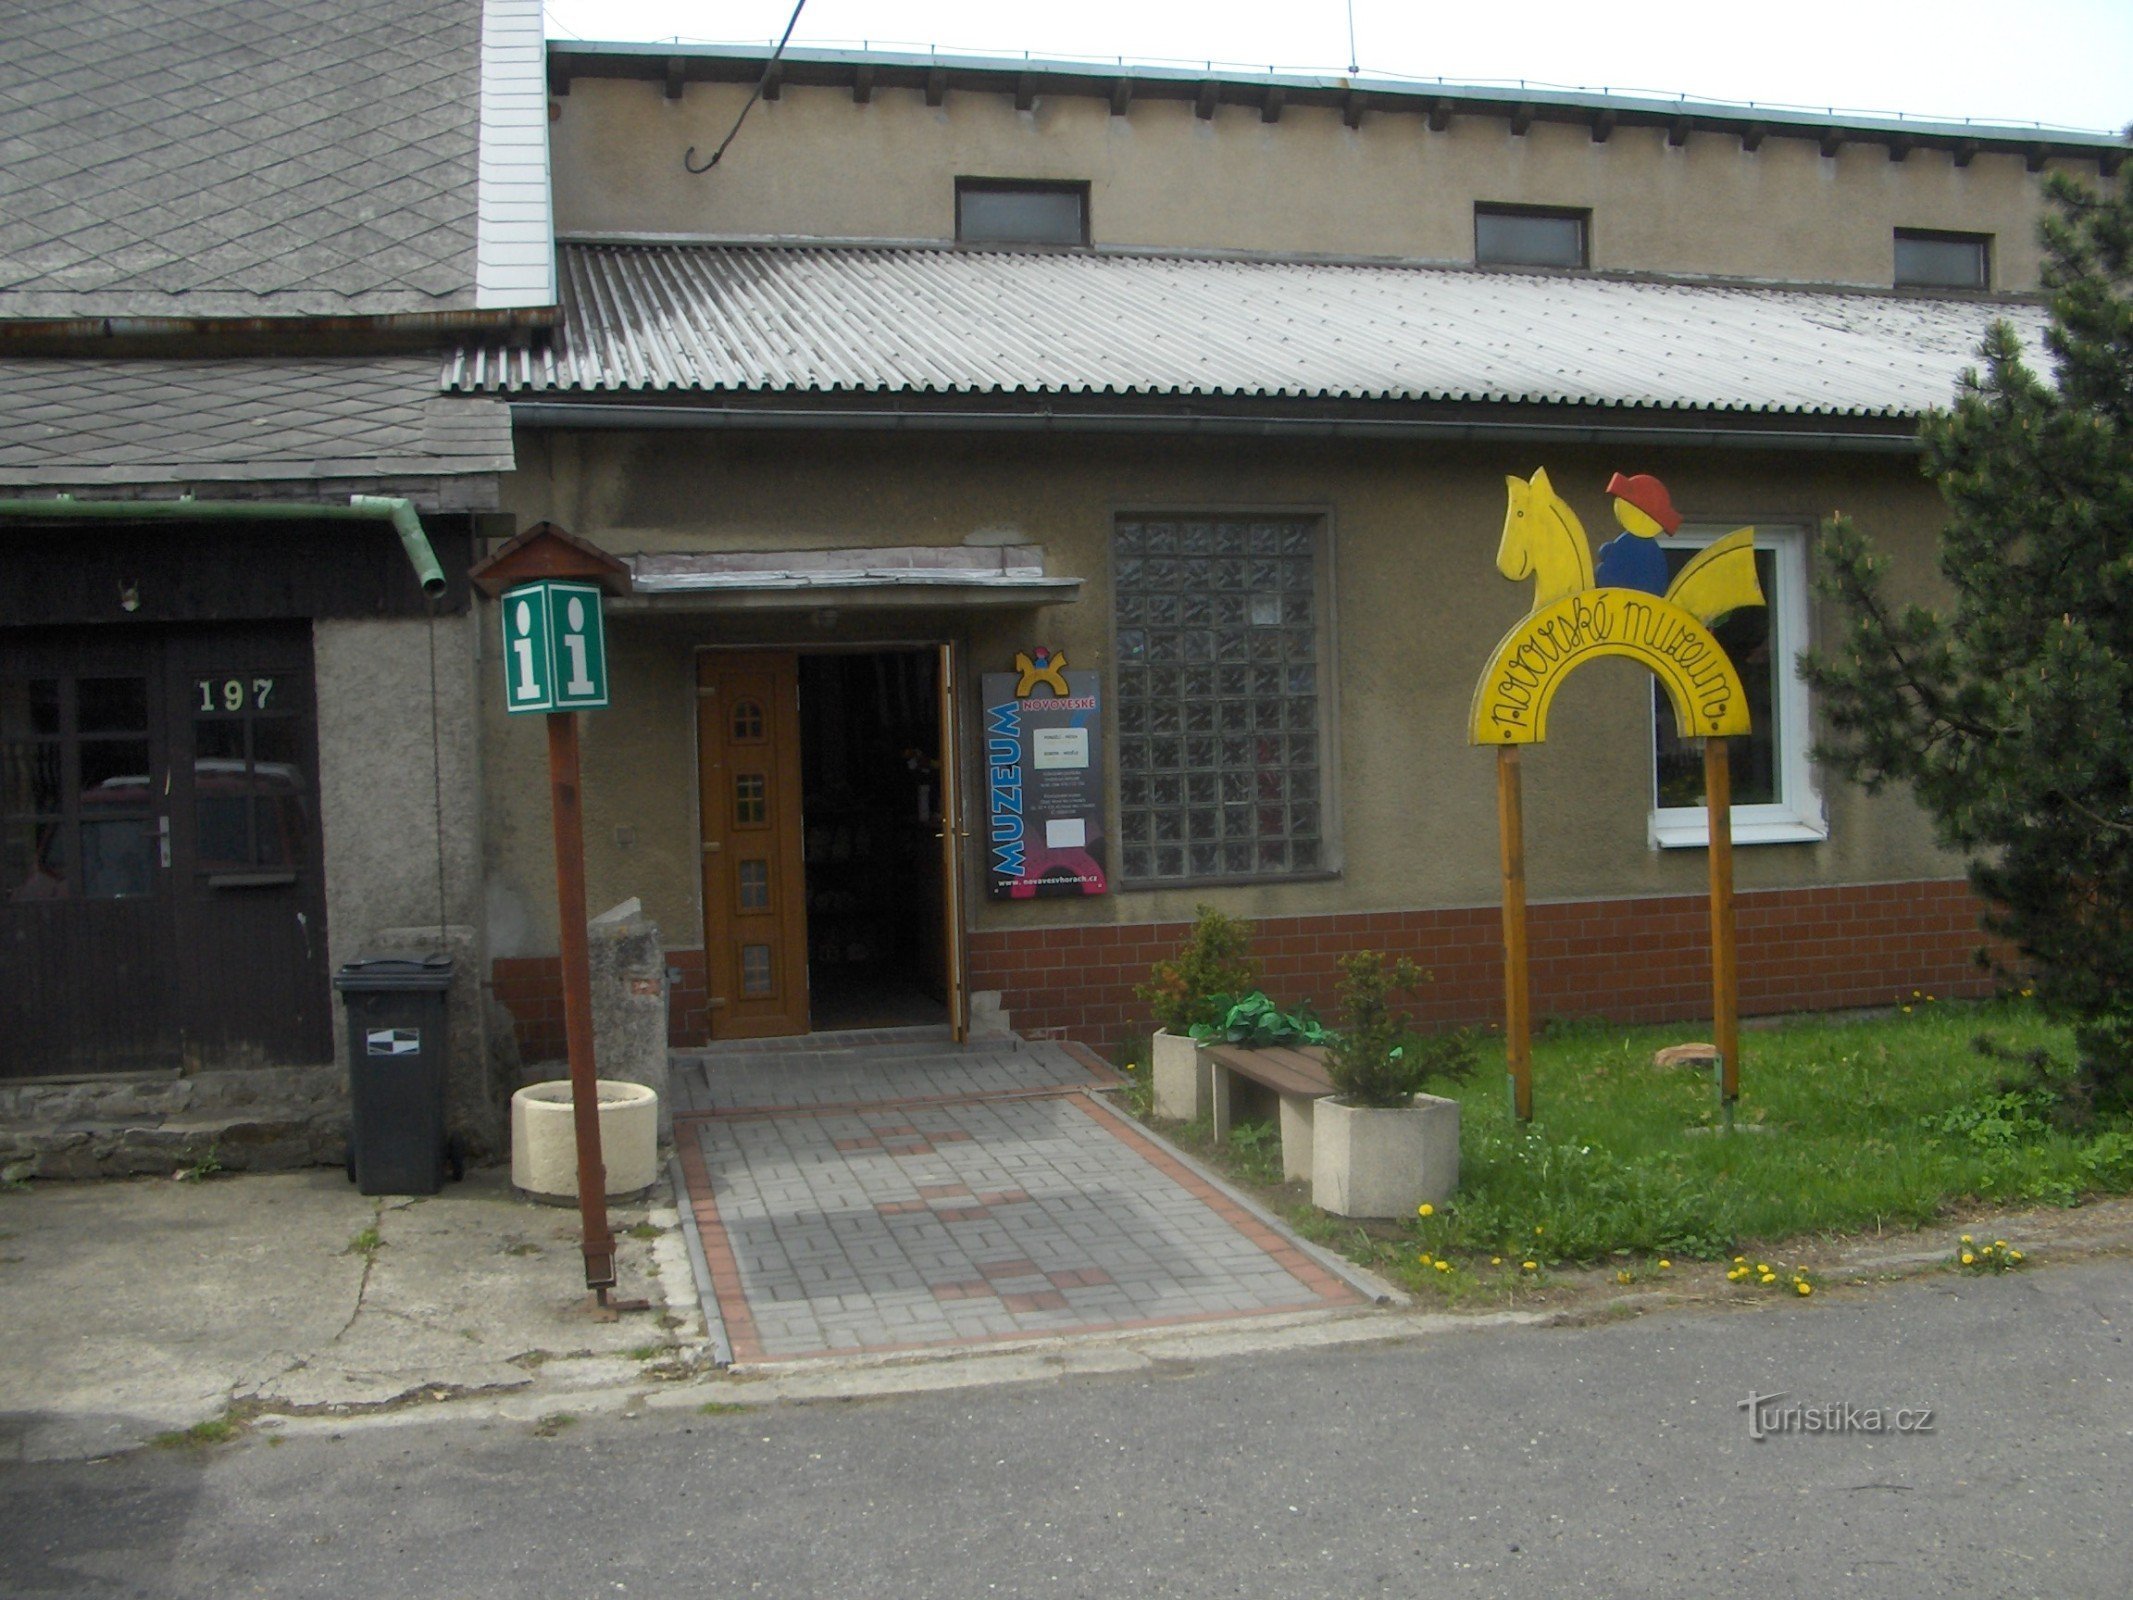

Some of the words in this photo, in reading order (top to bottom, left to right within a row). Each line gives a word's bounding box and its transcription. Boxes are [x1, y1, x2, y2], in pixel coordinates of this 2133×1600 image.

[199, 678, 273, 711] 197
[1622, 600, 1731, 719] muzeum
[987, 700, 1026, 877] MUZEUM
